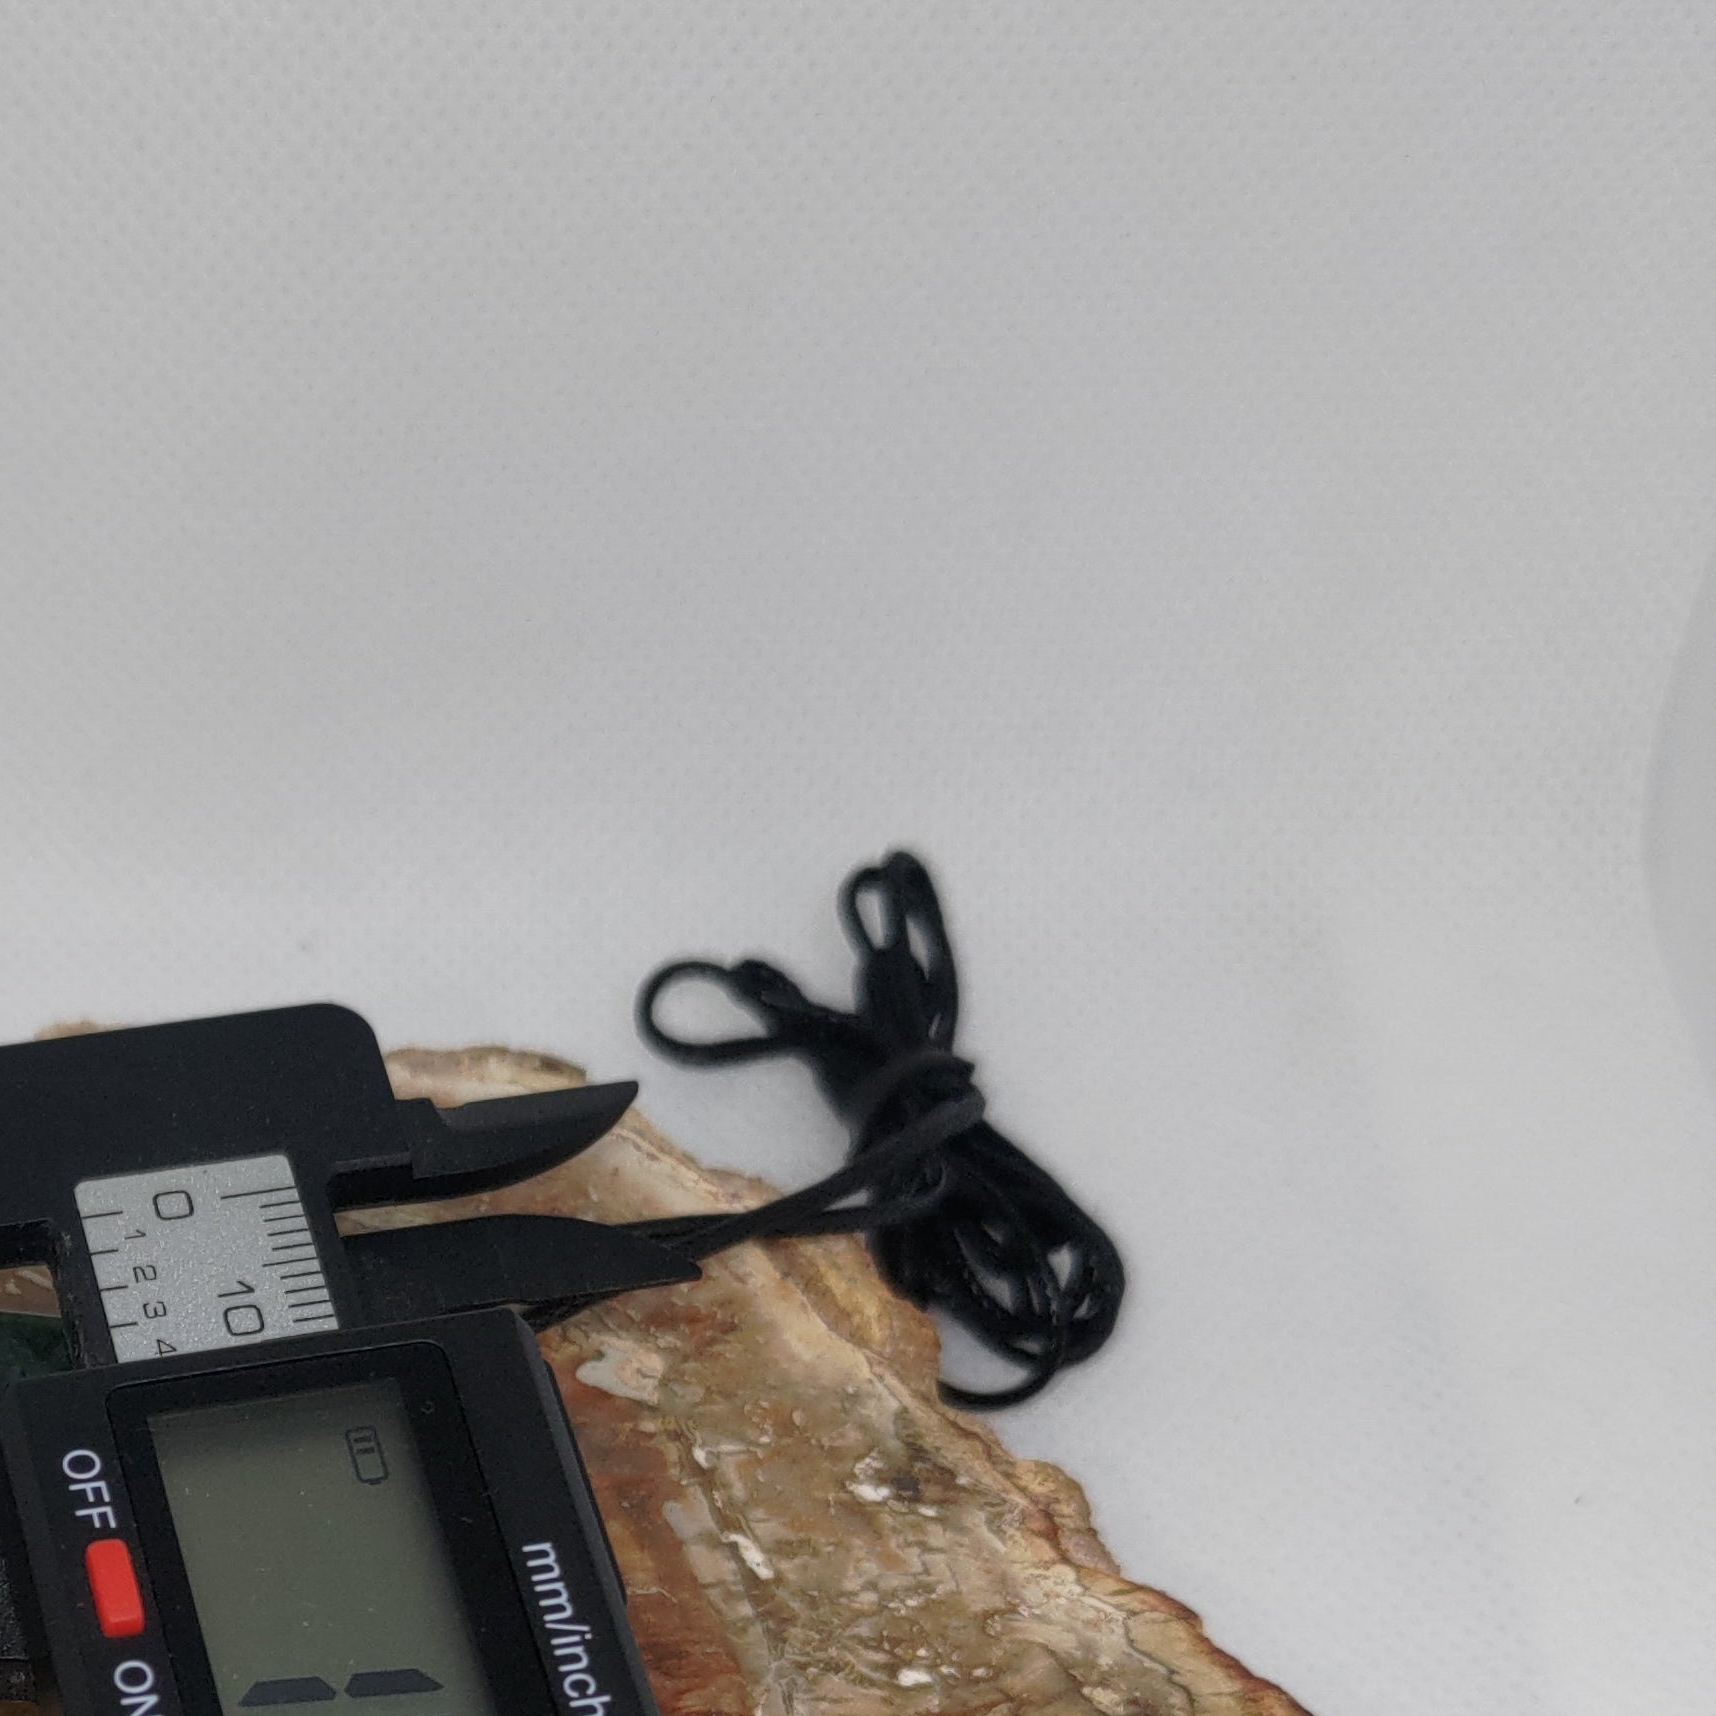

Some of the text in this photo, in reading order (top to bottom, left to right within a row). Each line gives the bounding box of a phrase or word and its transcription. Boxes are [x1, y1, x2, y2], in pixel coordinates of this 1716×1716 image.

[124, 1229, 177, 1356] 1 2 3 4
[153, 1190, 265, 1336] 0 10
[61, 1449, 117, 1529] OFF
